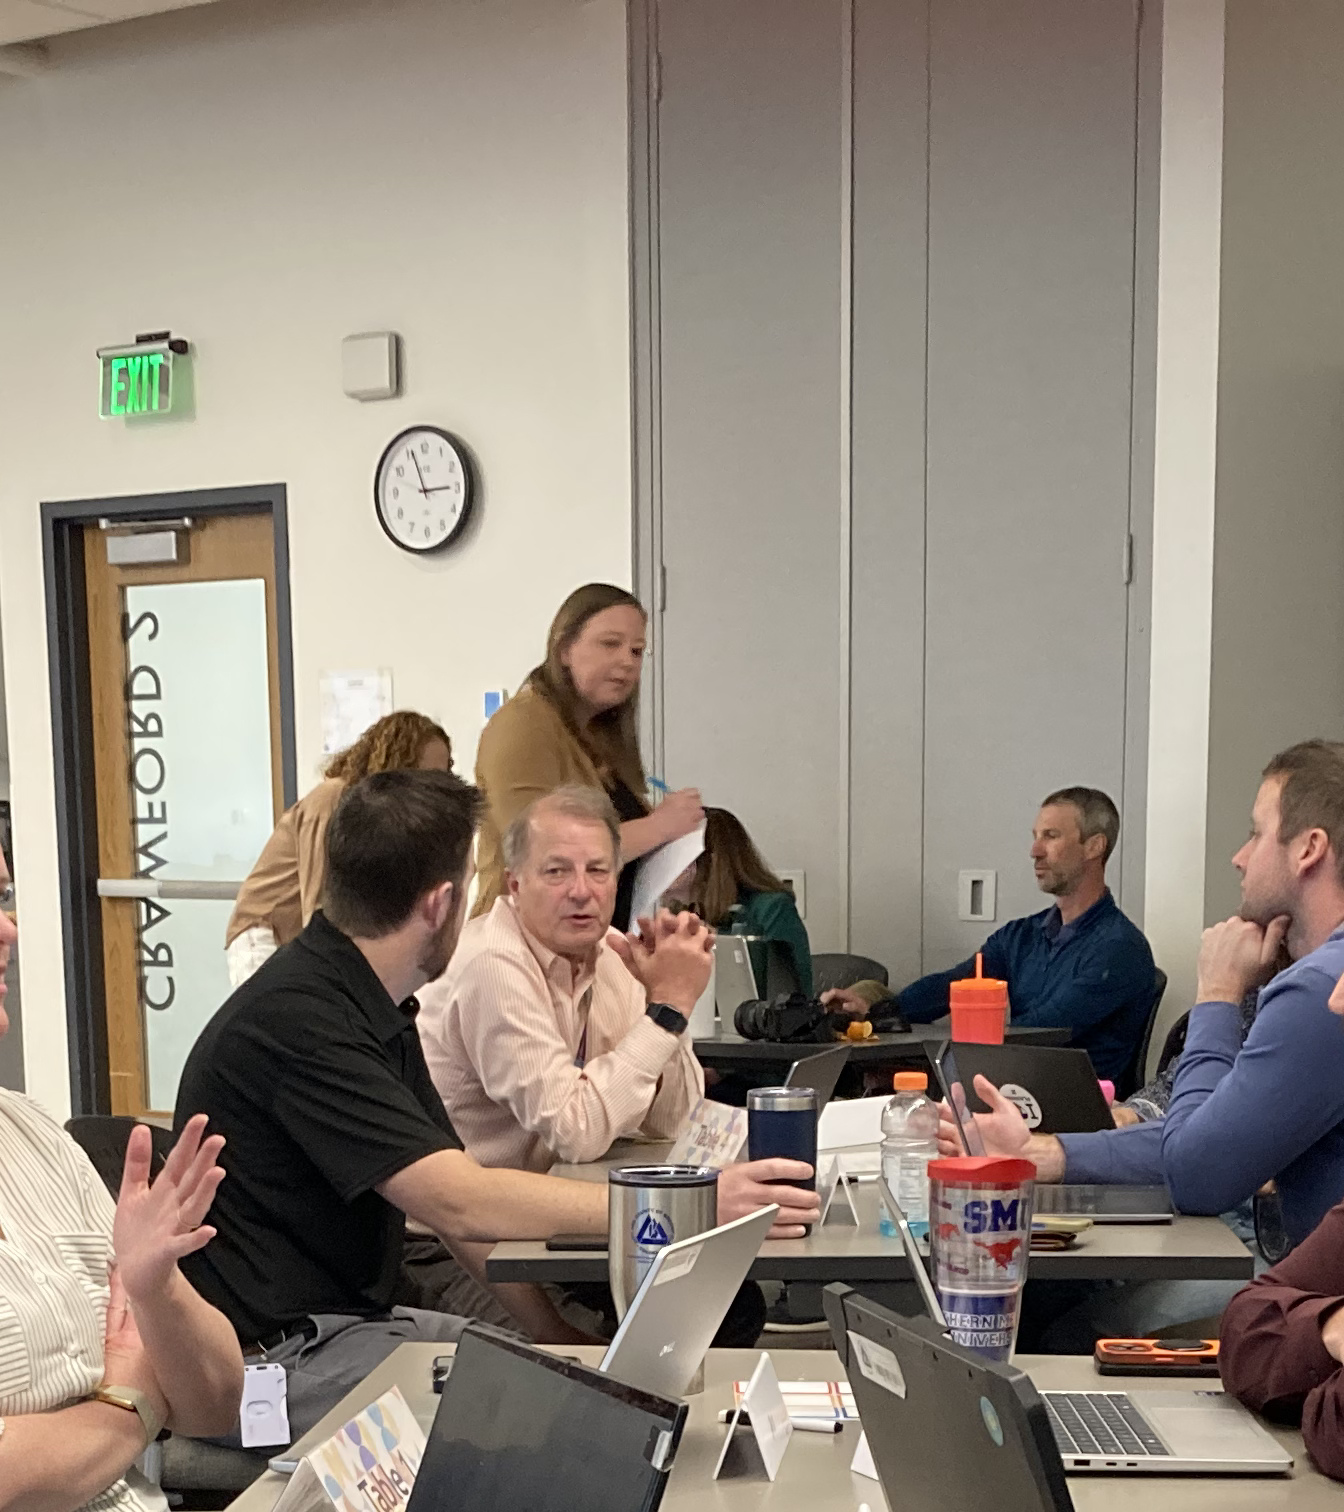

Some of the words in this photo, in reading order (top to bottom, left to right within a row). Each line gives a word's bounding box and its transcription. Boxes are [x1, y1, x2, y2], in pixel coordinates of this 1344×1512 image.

[110, 354, 164, 415] EXIT
[420, 440, 429, 455] 12
[396, 465, 405, 478] 10
[944, 1311, 995, 1329] HERN
